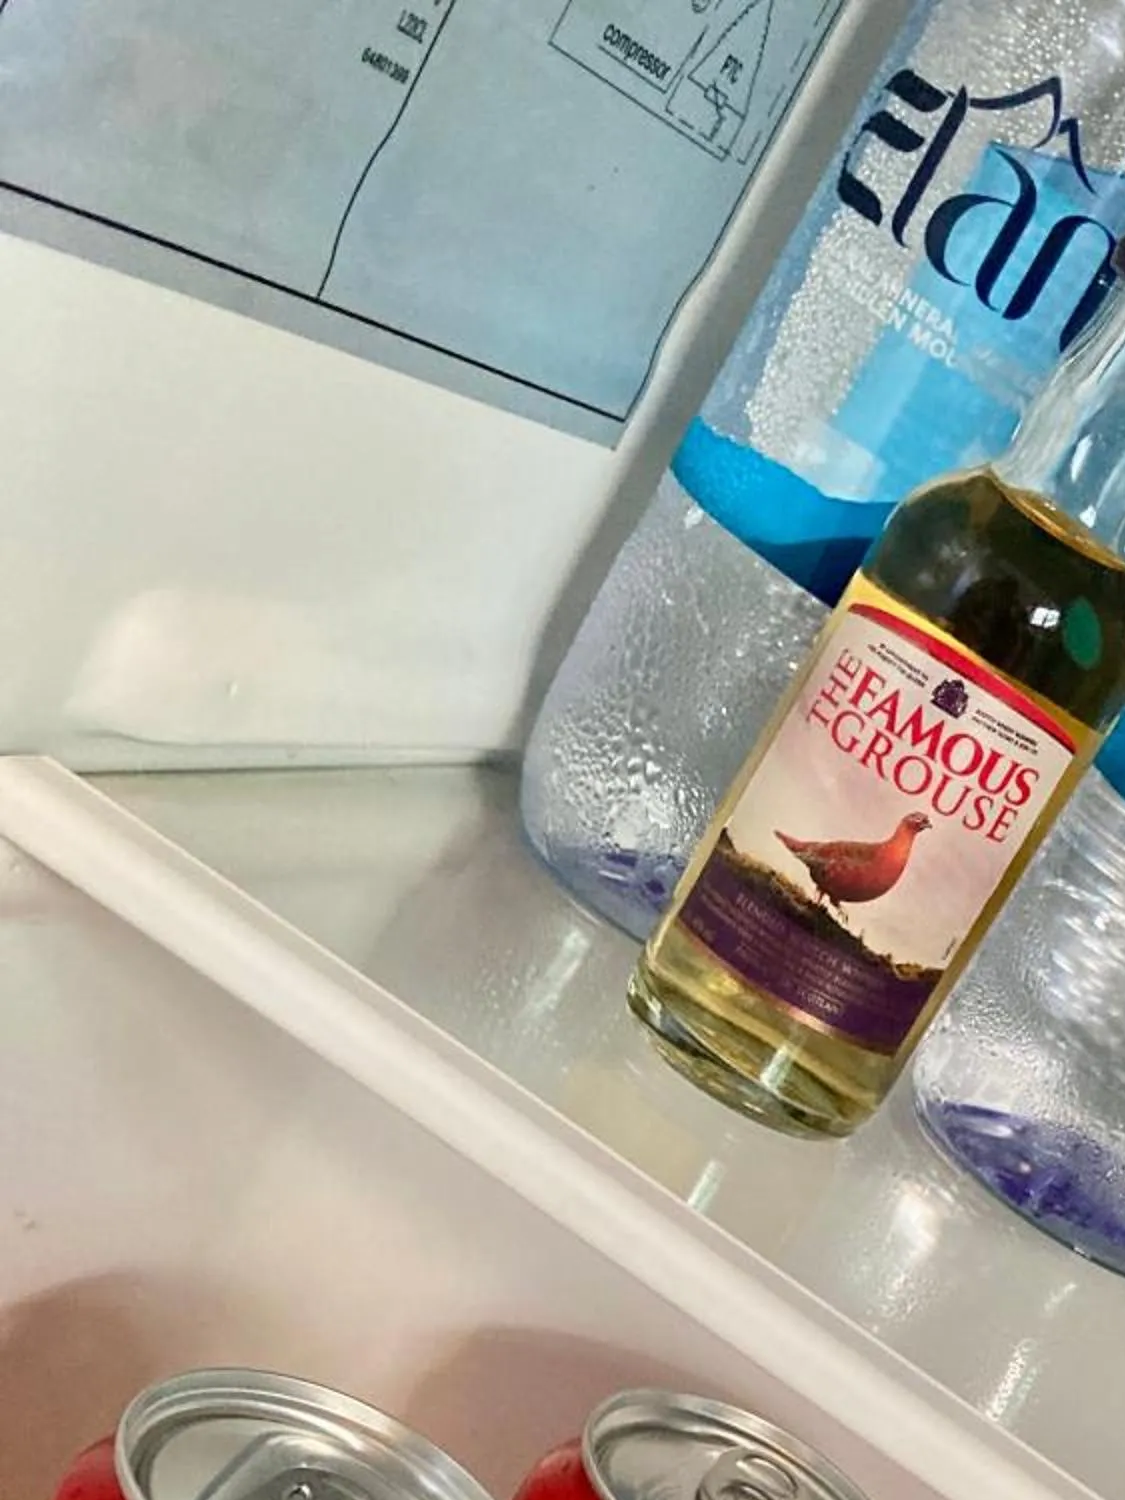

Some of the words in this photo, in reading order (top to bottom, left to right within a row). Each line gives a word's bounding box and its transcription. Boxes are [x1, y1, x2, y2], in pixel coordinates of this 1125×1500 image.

[603, 24, 672, 80] compressor
[720, 54, 743, 84] PTC
[806, 648, 864, 728] THE
[848, 665, 1040, 806] FAMOUS
[831, 709, 1019, 843] GROUSE
